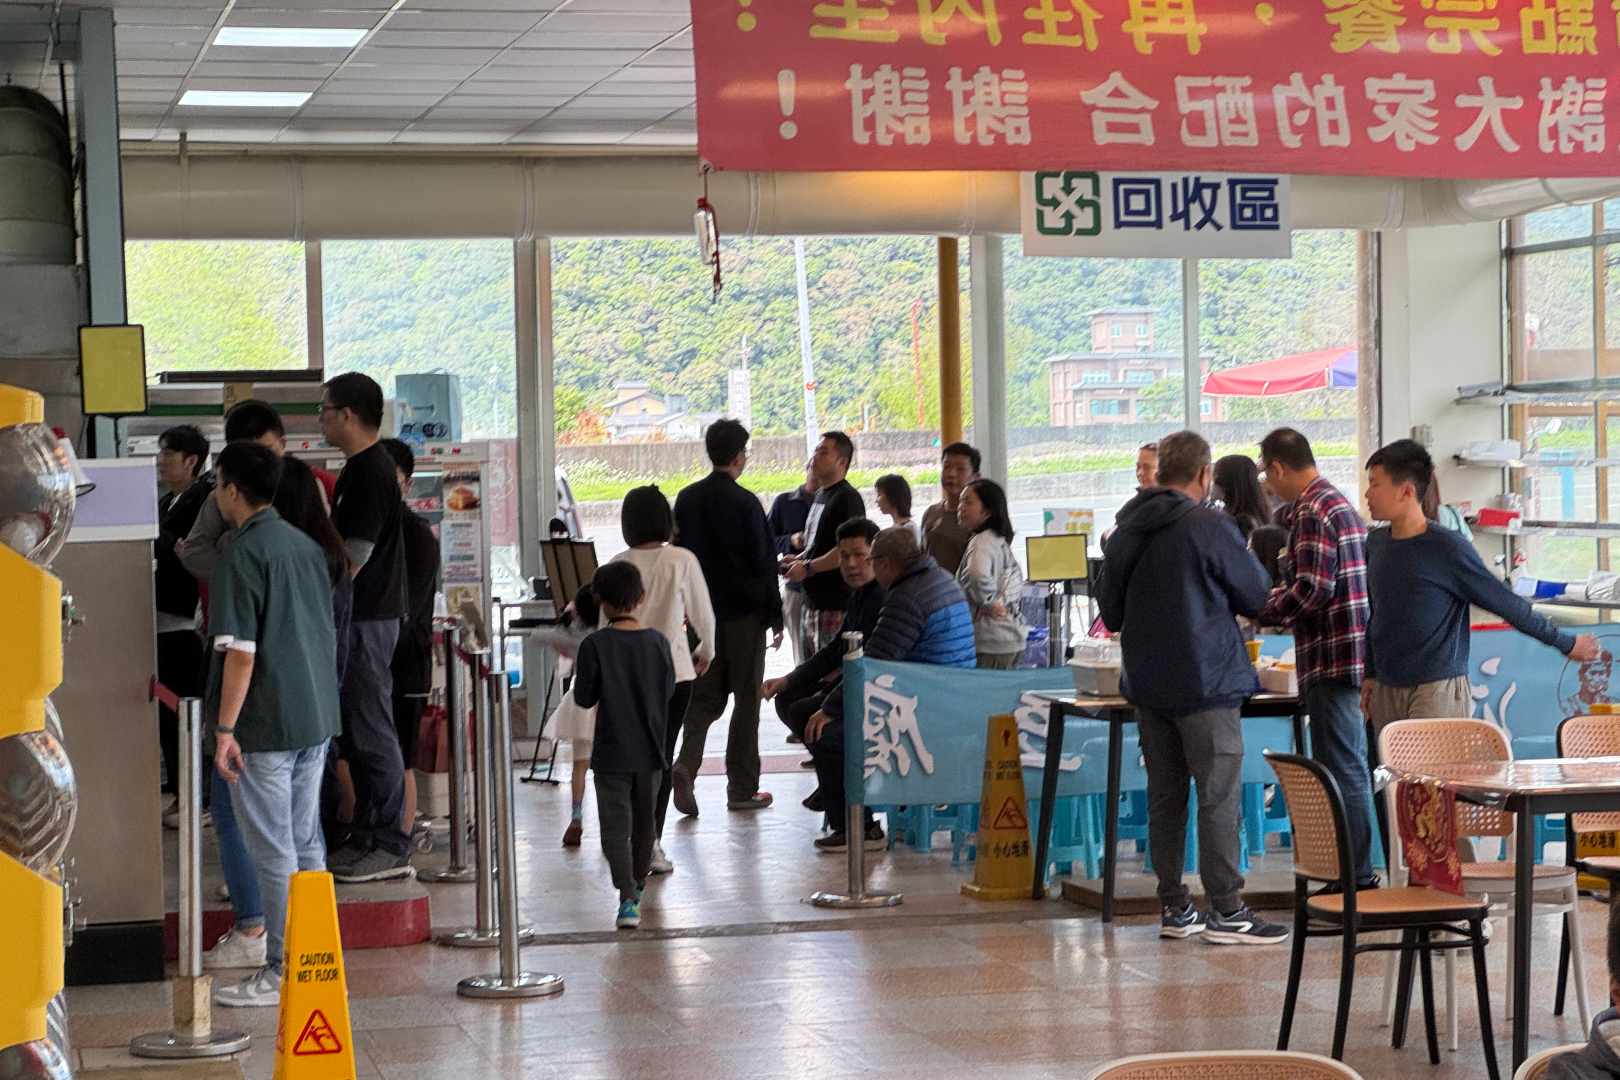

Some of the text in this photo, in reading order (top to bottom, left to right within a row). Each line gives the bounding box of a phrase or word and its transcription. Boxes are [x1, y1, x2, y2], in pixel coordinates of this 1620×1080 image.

[1112, 176, 1281, 231] 回收區
[299, 952, 335, 966] CAUTION
[297, 968, 339, 983] WET FLOOR
